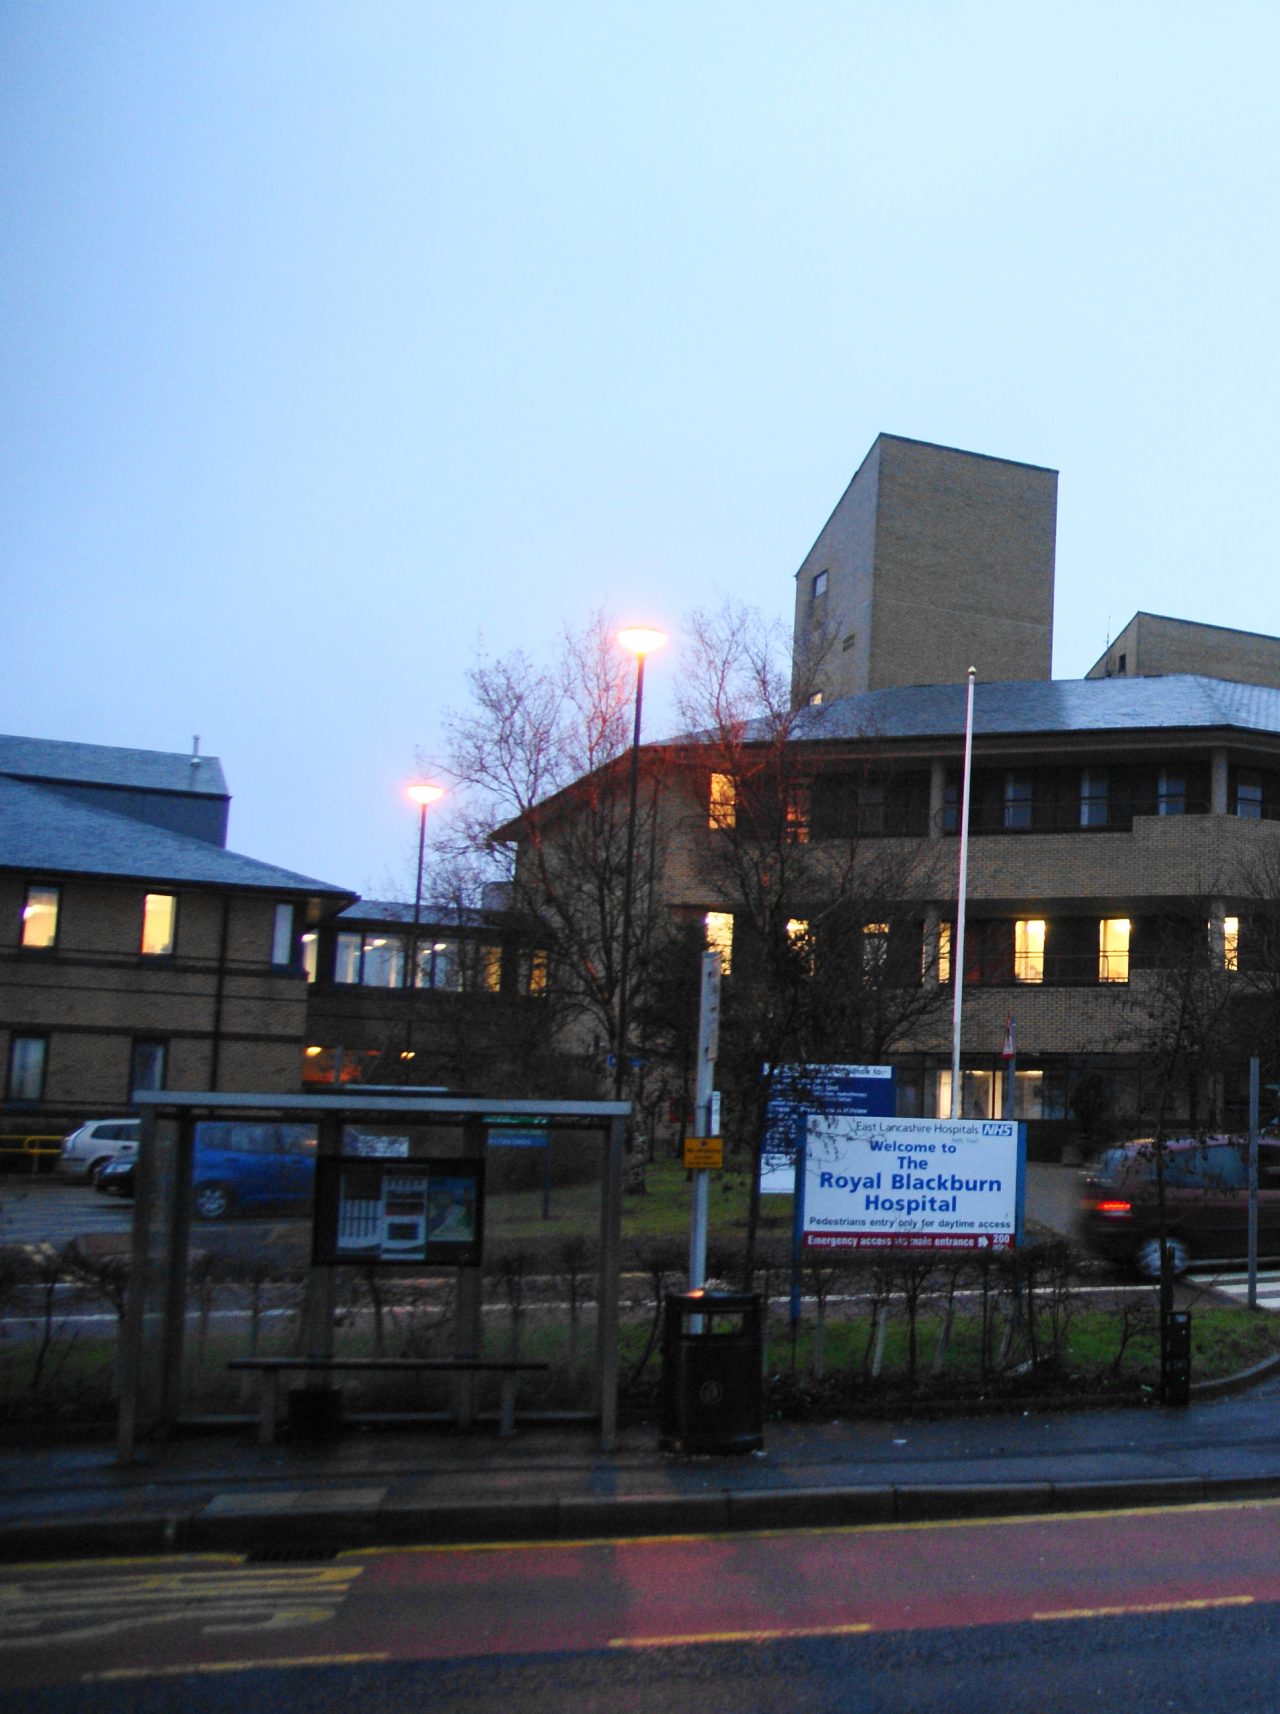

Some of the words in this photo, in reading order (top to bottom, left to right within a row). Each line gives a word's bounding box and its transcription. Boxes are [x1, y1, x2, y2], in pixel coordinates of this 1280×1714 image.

[856, 1121, 877, 1131] East
[880, 1122, 932, 1133] Lancashire
[935, 1124, 979, 1135] Hospitals
[984, 1125, 1012, 1136] NHS
[870, 1140, 936, 1153] Welcome
[941, 1143, 957, 1153] to
[897, 1157, 928, 1170] The
[820, 1172, 882, 1193] Royal
[891, 1173, 1002, 1192] Blackburn
[865, 1195, 957, 1215] Hospital
[809, 1217, 866, 1227] Pedestrians
[870, 1219, 894, 1229] entry
[898, 1218, 917, 1229] only
[921, 1218, 934, 1229] for
[938, 1218, 975, 1230] daytime
[978, 1221, 1011, 1229] access
[808, 1235, 857, 1247] Emergency
[860, 1237, 891, 1246] access
[935, 1236, 974, 1247] entrance
[993, 1233, 1010, 1244] 200
